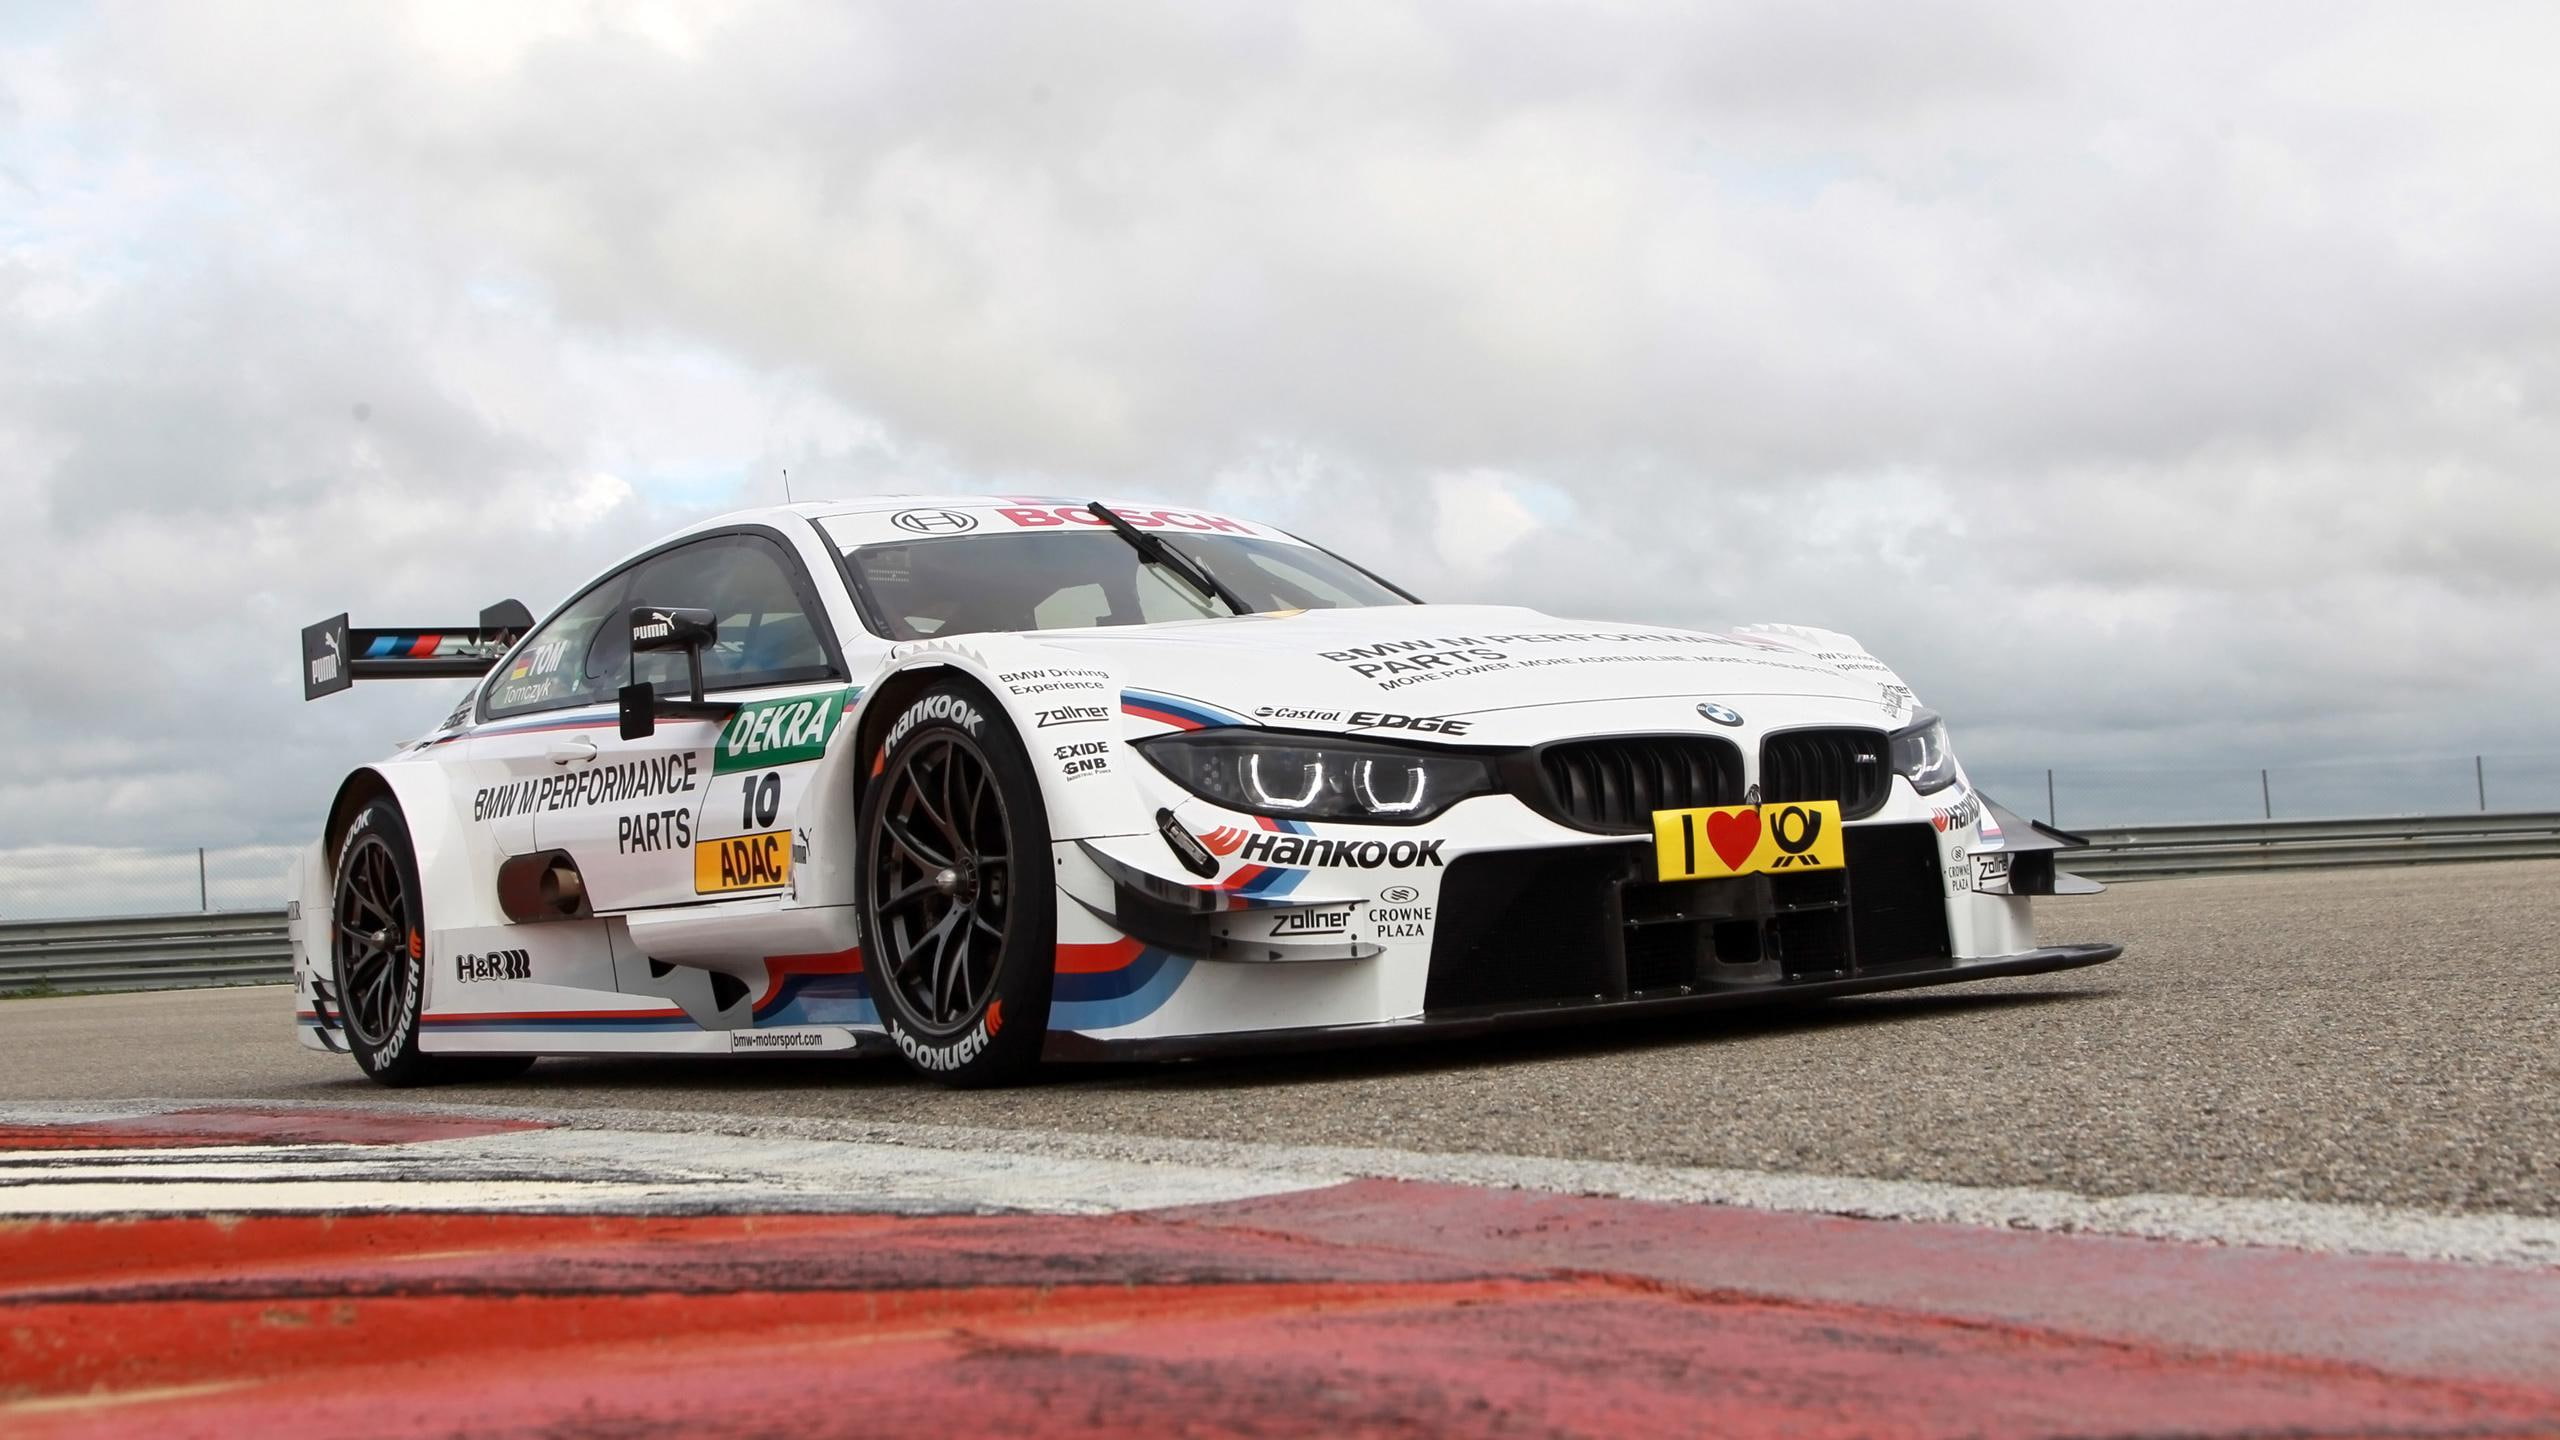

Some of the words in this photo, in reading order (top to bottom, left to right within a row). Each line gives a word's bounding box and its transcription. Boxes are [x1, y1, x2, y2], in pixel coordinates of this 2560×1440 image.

[995, 508, 1258, 535] BOSCH
[633, 623, 668, 640] PUMA
[529, 640, 566, 676] TOM
[1317, 639, 1436, 661] BMW
[1437, 637, 1486, 647] M
[311, 653, 337, 685] PUMA
[999, 669, 1045, 682] BMW
[1048, 667, 1110, 679] Driving
[1349, 648, 1507, 678] PARTS
[503, 679, 552, 704] Tomczyk
[1009, 681, 1105, 695] Experience
[1379, 673, 1441, 691] MORE
[728, 697, 833, 757] DEKRA
[1275, 707, 1341, 721] Castrol
[1346, 711, 1475, 736] EDGE
[1054, 741, 1109, 760] EXIDE
[1063, 757, 1107, 775] GNB
[475, 782, 519, 821] BMW
[517, 779, 539, 814] M
[539, 752, 696, 813] PERFORMANCE
[742, 772, 781, 830] 10
[619, 808, 691, 854] PARTS
[1682, 814, 1694, 875] I
[721, 836, 782, 887] ADAC
[1369, 907, 1432, 922] CROWNE
[1377, 924, 1425, 937] PLAZA
[733, 1032, 822, 1049] bmw-motorsport.com
